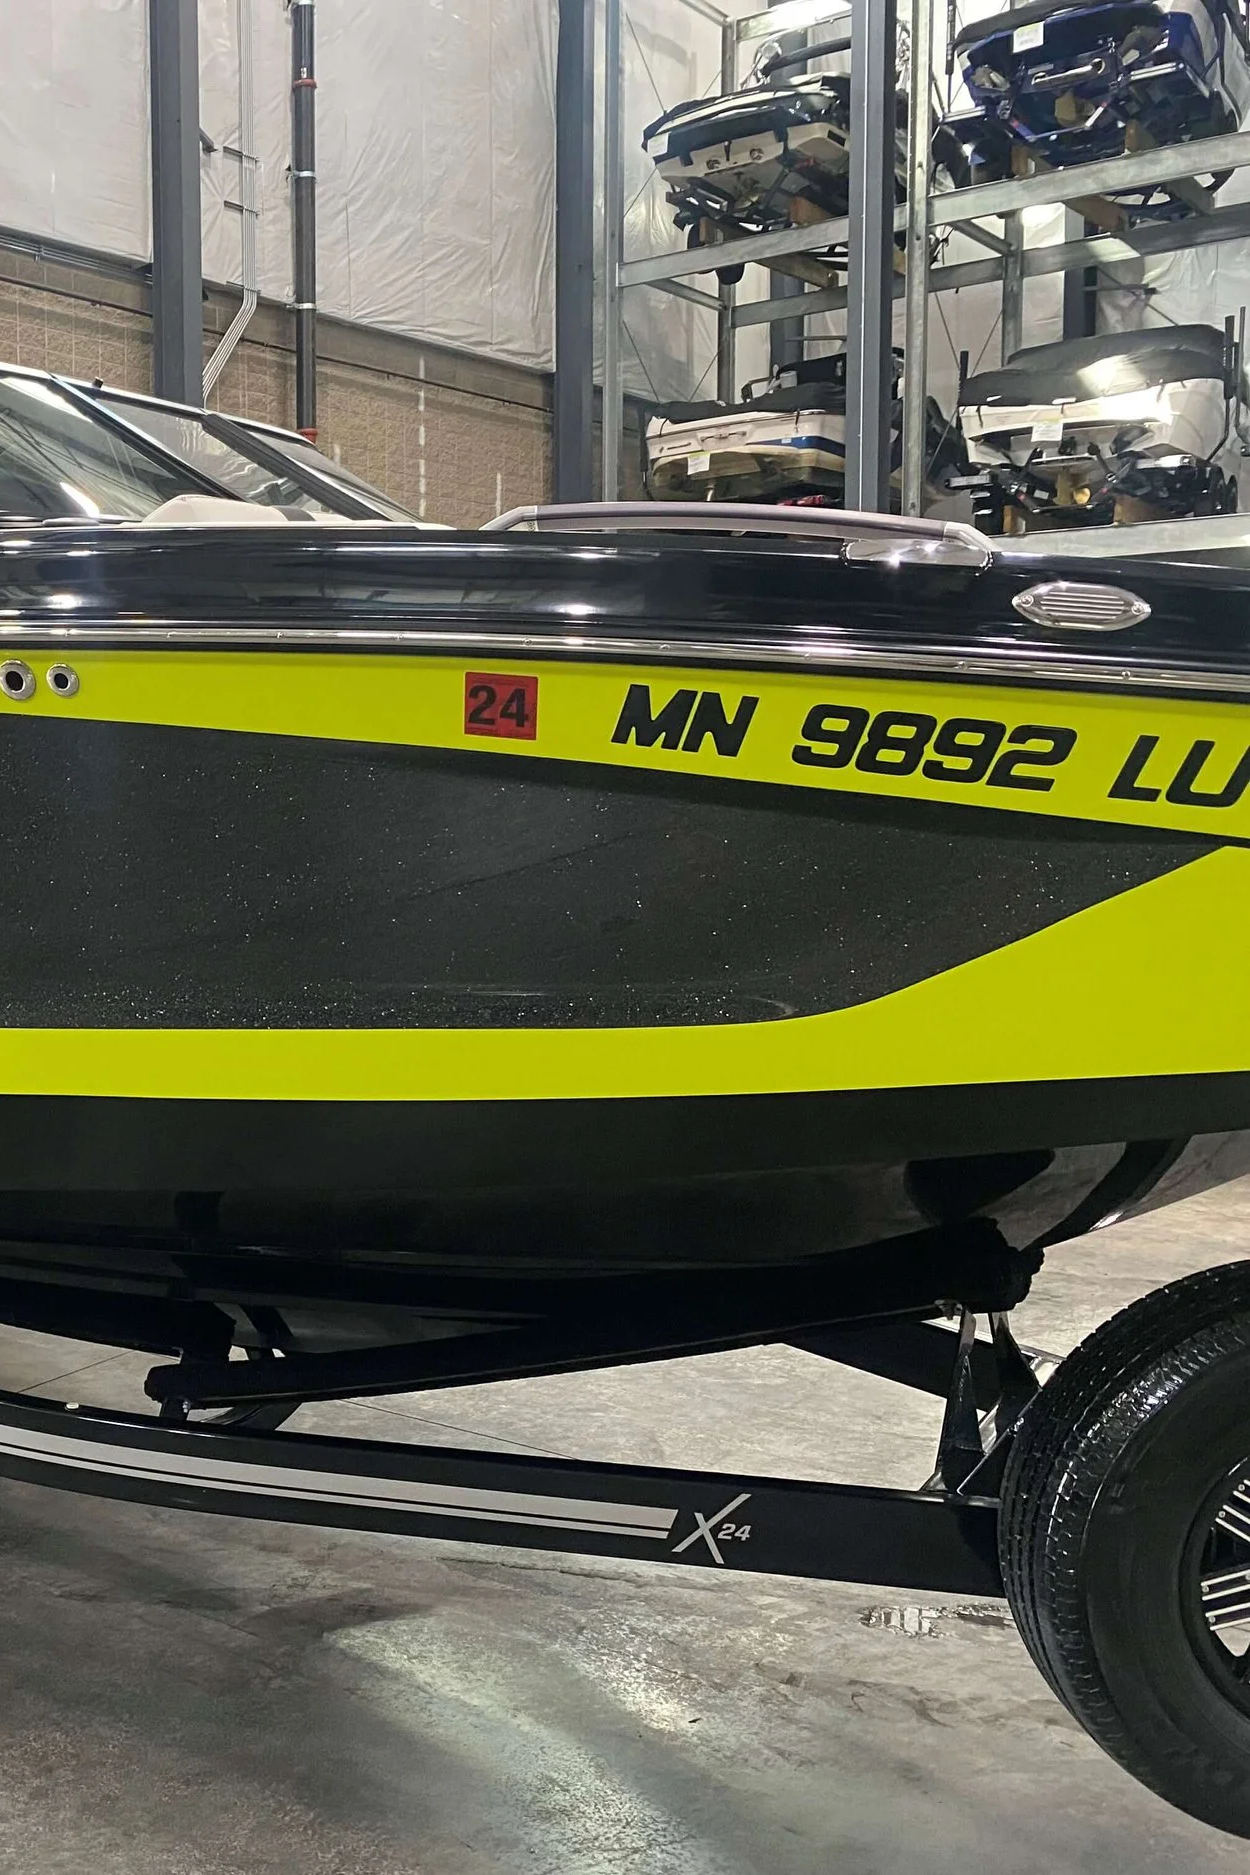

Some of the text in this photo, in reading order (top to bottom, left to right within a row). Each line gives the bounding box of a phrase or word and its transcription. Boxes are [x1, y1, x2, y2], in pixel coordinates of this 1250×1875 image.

[468, 684, 529, 728] 24
[611, 684, 1250, 807] MN 9892 LU
